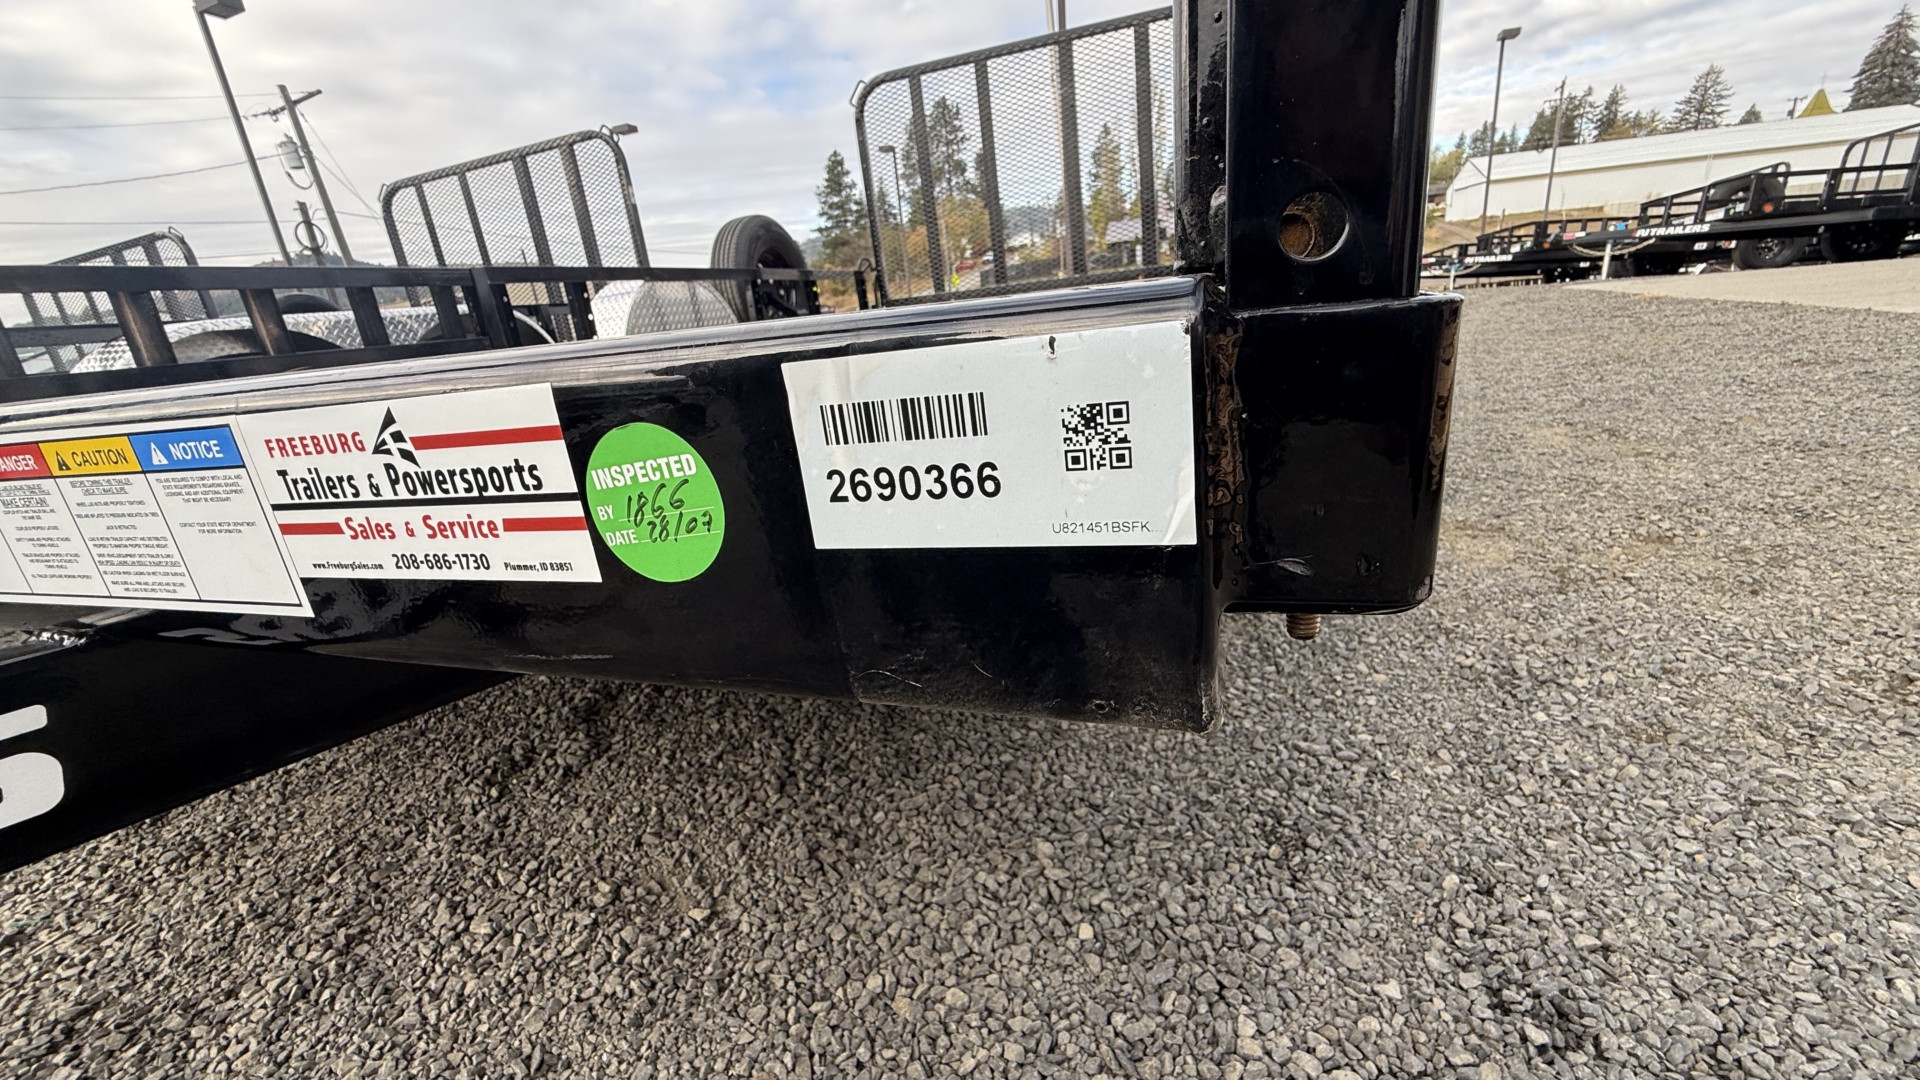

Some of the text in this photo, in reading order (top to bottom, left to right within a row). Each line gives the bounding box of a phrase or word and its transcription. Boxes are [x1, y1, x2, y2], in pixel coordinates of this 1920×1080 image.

[168, 440, 224, 461] NOTICE
[264, 431, 367, 459] FREEBURG
[0, 454, 39, 472] ANGER
[71, 448, 129, 467] CAUTION
[277, 458, 544, 501] Trailers & Powersports
[591, 453, 697, 490] INSPECTED
[826, 461, 1002, 503] 2690366
[597, 505, 614, 521] BY
[626, 478, 690, 528] 1866
[344, 513, 501, 541] Sales & Service
[605, 529, 639, 546] DATE
[312, 561, 384, 572] www.FreeburgSales.com
[391, 553, 491, 571] 208-686-1730
[503, 562, 574, 573] Plummer, ID 83851
